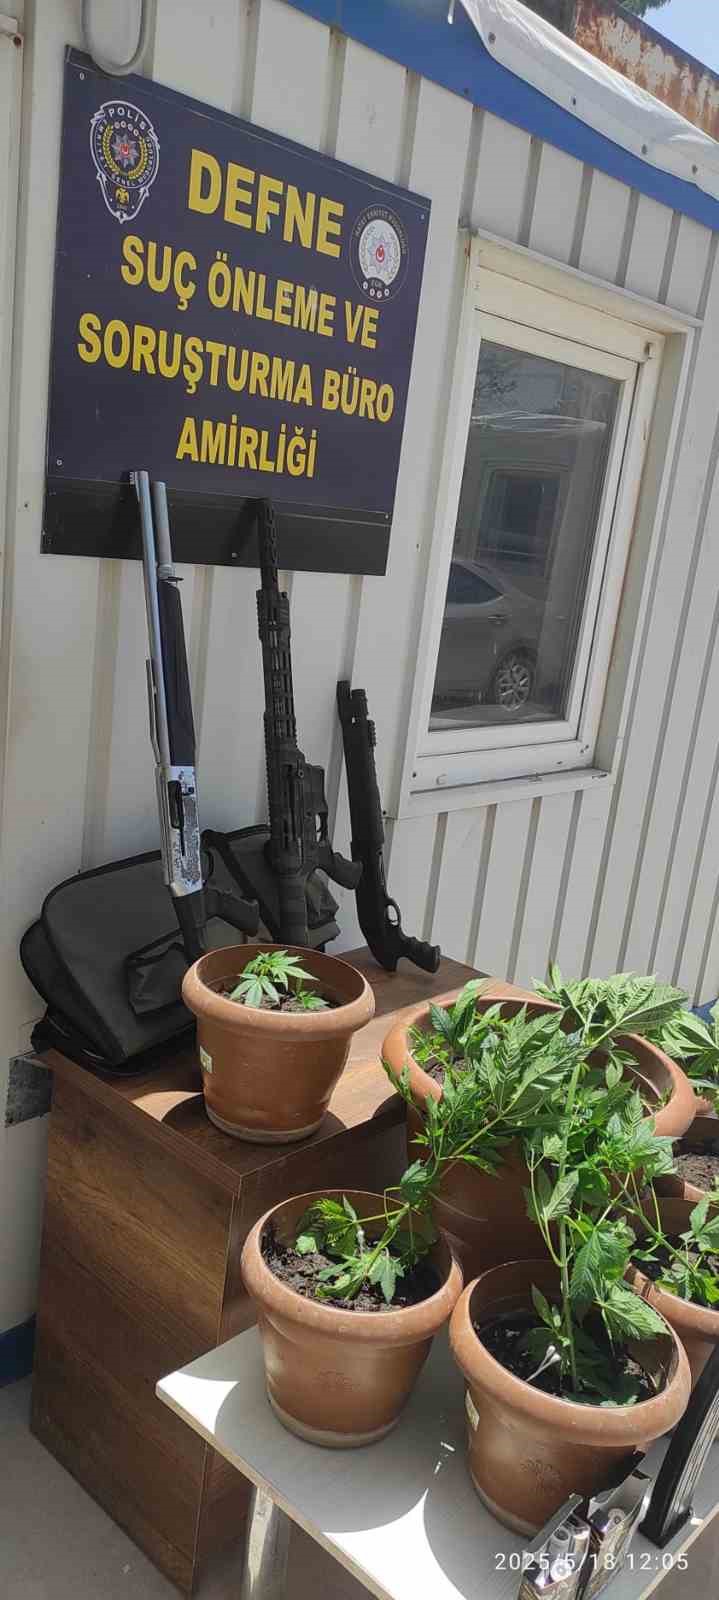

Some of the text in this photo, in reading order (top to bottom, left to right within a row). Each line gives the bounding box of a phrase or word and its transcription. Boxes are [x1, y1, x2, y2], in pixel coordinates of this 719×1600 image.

[187, 150, 344, 257] DEFNE
[119, 234, 379, 350] SUÇ ÖNLEME VE
[77, 312, 394, 423] SORUŞTURMA BÜRO
[175, 413, 317, 479] AMİRLİĞİ
